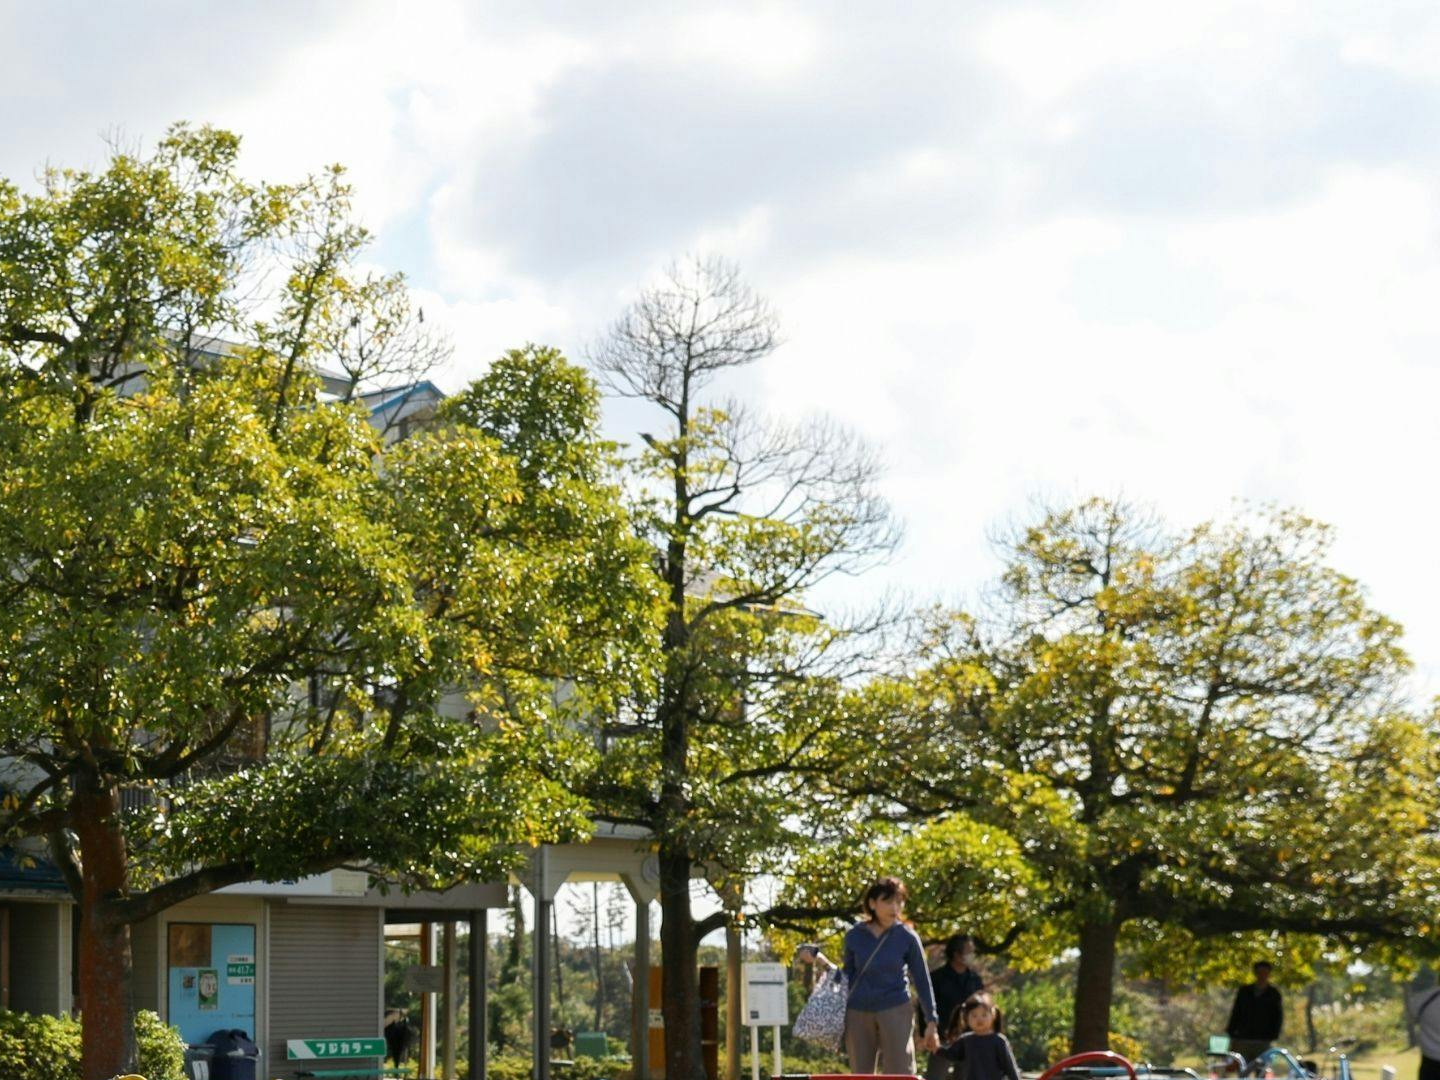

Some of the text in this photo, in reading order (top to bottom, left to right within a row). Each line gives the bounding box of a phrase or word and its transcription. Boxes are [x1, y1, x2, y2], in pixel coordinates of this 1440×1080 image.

[316, 1042, 372, 1055] フジカラー
